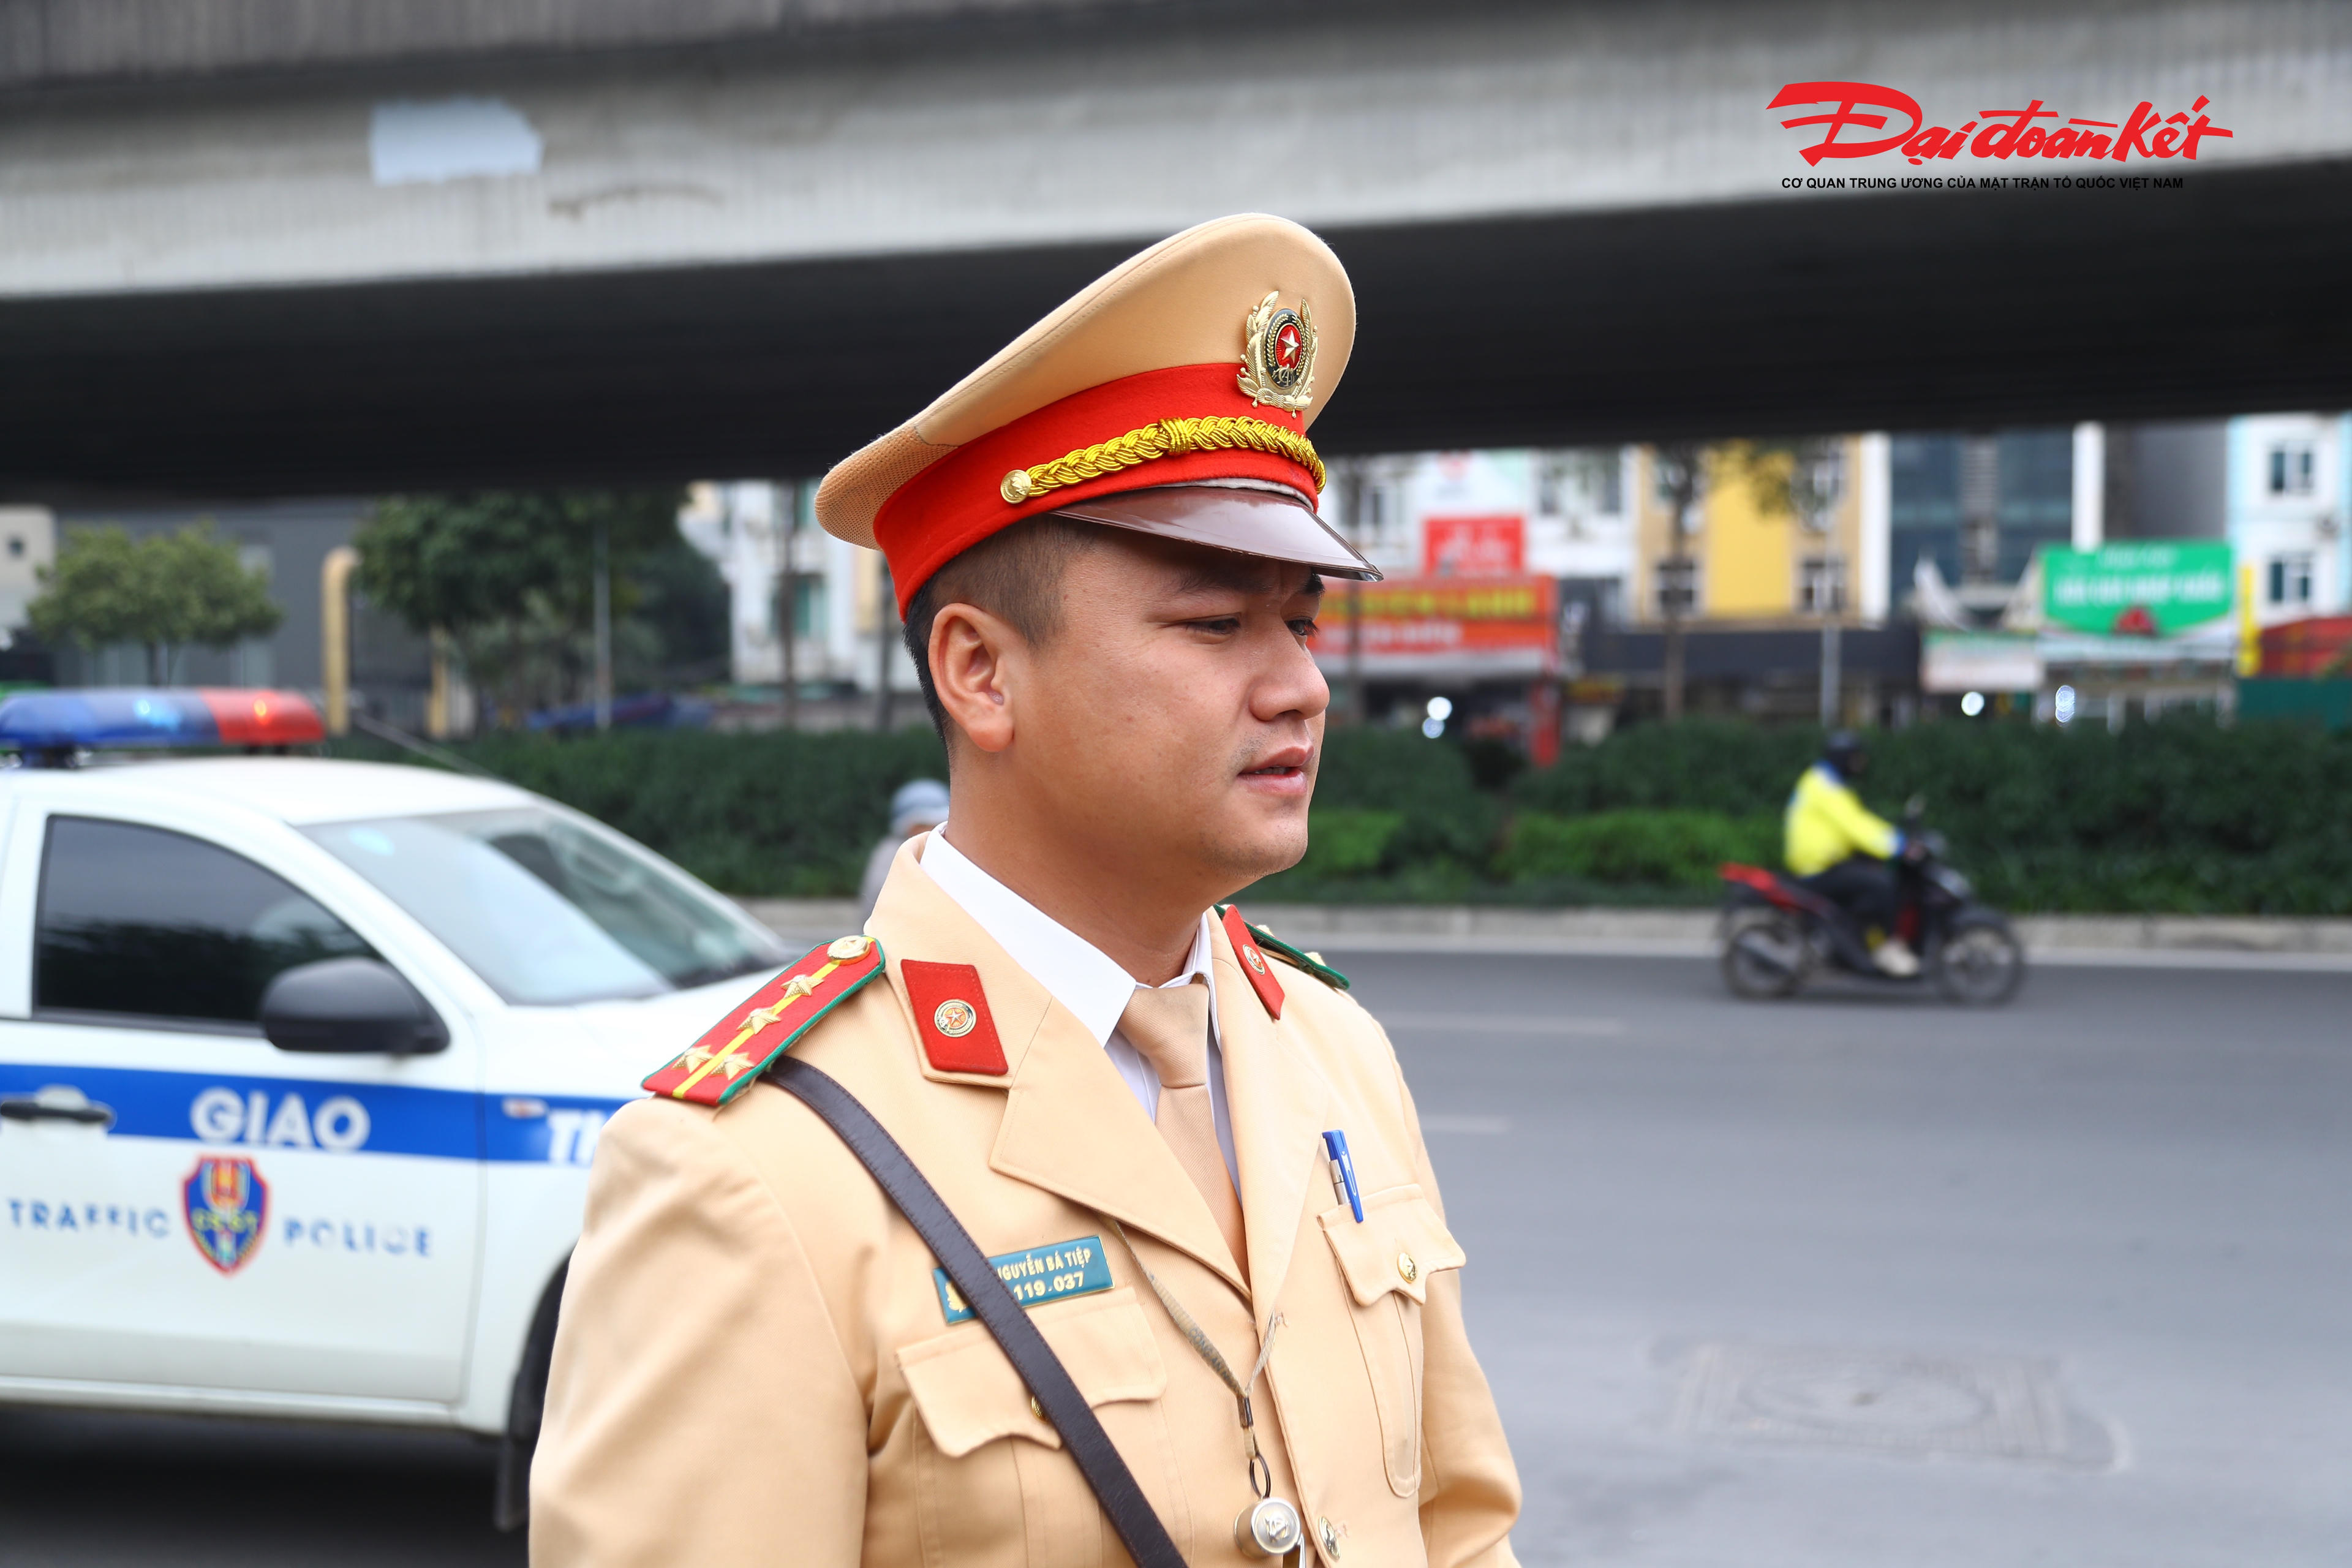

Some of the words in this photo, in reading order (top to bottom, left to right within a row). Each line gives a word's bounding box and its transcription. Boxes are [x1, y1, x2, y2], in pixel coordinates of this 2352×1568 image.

[190, 1087, 371, 1150] GIAO
[1046, 1250, 1065, 1272] BÁ
[1065, 1246, 1092, 1268] TIỆP
